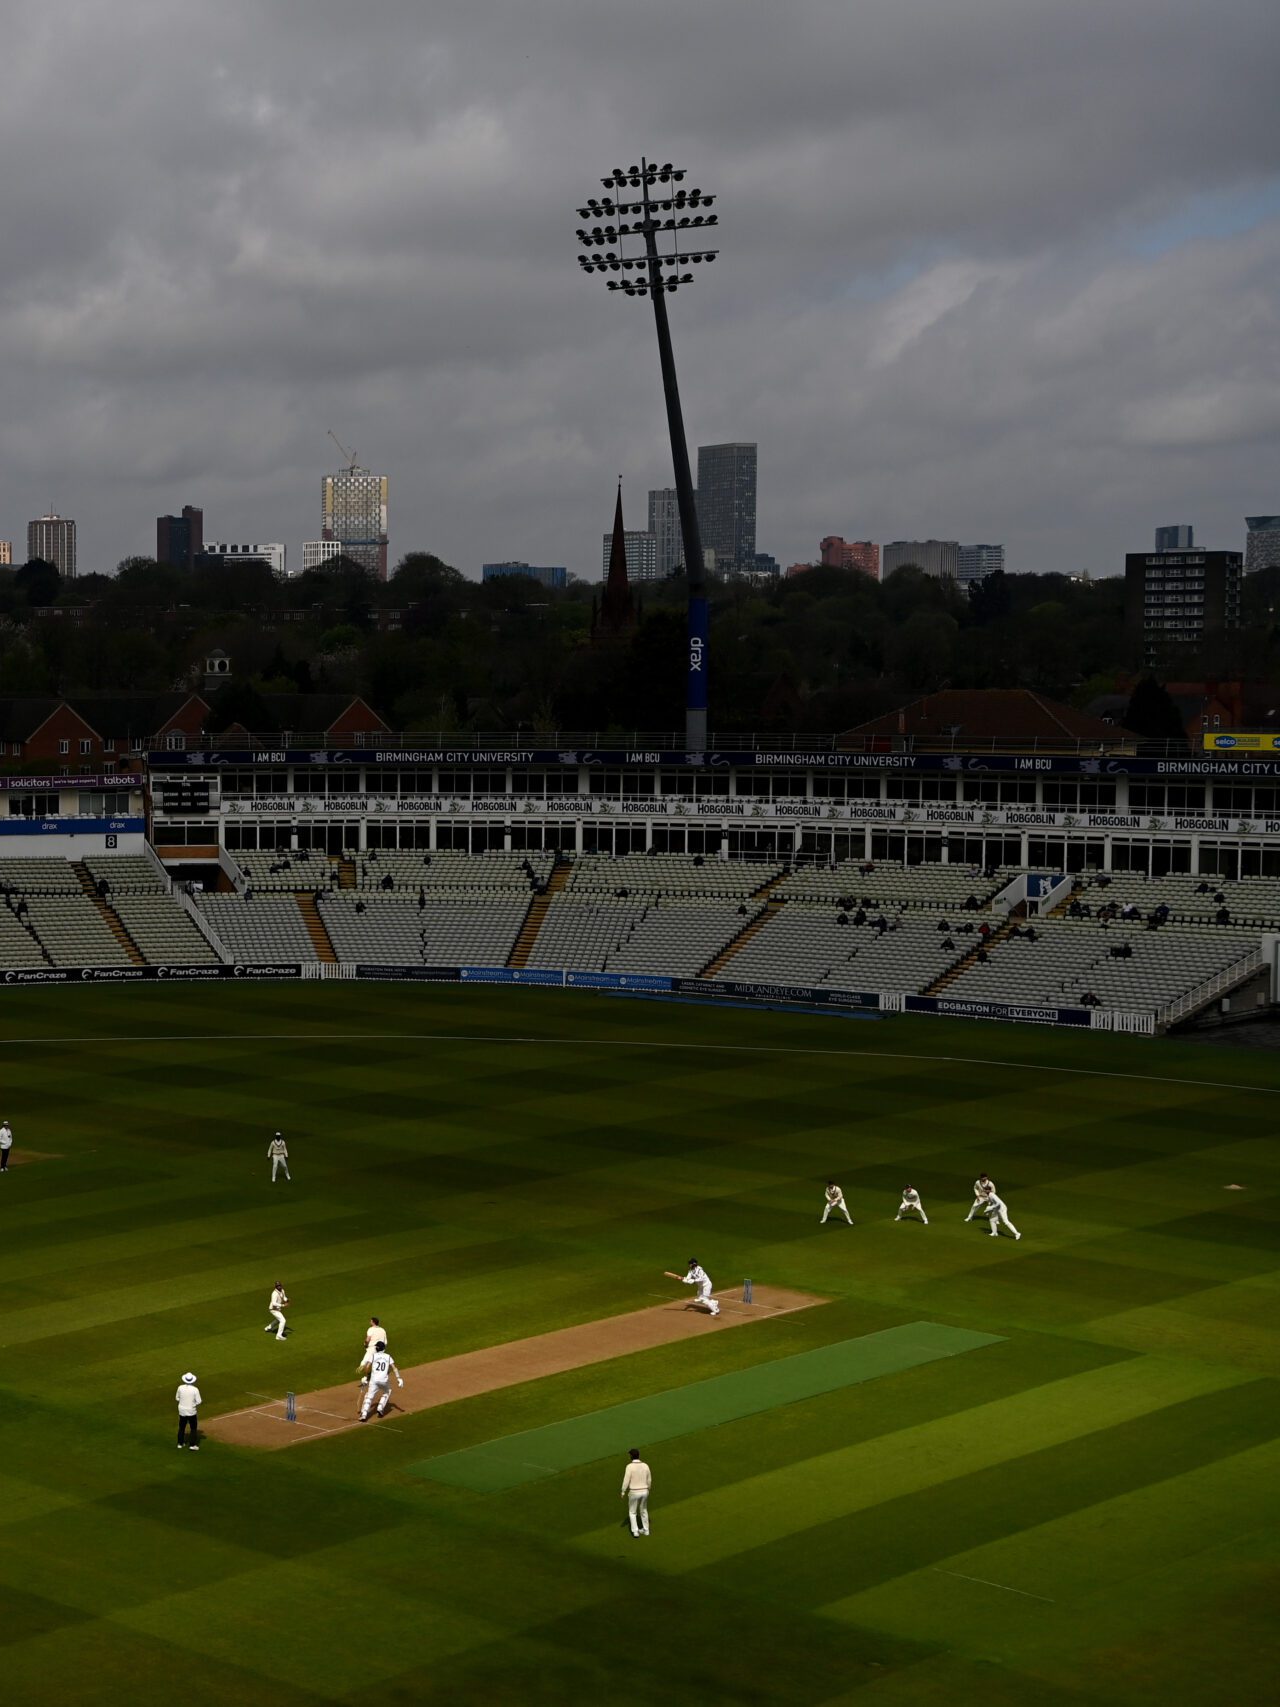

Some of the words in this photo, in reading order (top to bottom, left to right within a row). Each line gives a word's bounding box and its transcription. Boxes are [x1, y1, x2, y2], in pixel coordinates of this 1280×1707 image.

[690, 637, 704, 671] drax
[252, 753, 256, 763] I
[257, 754, 269, 763] AM
[271, 754, 286, 763] BCU
[376, 752, 443, 763] BIRMINGHAM
[446, 752, 468, 763] CITY
[473, 752, 534, 763] UNIVERSITY
[626, 754, 629, 763] I
[631, 754, 642, 763] AM
[645, 754, 660, 763] BCU
[755, 755, 823, 766] BIRMINGHAM
[827, 755, 850, 766] CITY
[854, 756, 916, 766] UNIVERSITY
[1015, 758, 1018, 768] I
[1020, 757, 1033, 769] AM
[1035, 757, 1052, 769] BCU
[1157, 762, 1237, 774] BIRMINGHAM
[1242, 763, 1267, 774] CITY
[10, 777, 50, 787] solicitors
[104, 775, 135, 784] talbots
[251, 801, 295, 812] HOBGOBLIN
[324, 801, 368, 812] HOBGOBLIN
[398, 801, 442, 812] HOBGOBLIN
[472, 801, 517, 812] HOBGOBLIN
[547, 801, 593, 812] HOBGOBLIN
[622, 803, 667, 814] HOBGOBLIN
[698, 804, 744, 815] HOBGOBLIN
[776, 805, 820, 816] HOBGOBLIN
[851, 807, 896, 818] HOBGOBLIN
[927, 810, 974, 821] HOBGOBLIN
[1007, 813, 1055, 824] HOBGOBLIN
[1089, 816, 1140, 828] HOBGOBLIN
[42, 822, 57, 830] drax
[110, 821, 125, 829] drax
[1175, 818, 1229, 831] HOBGOBLIN
[107, 836, 114, 847] 8
[17, 972, 67, 980] FanCraze
[170, 968, 219, 976] FanCraze
[938, 1001, 990, 1013] EDGBASTON
[991, 1007, 1007, 1015] FOR
[1010, 1008, 1057, 1019] EVERYONE
[376, 1361, 386, 1371] 20
